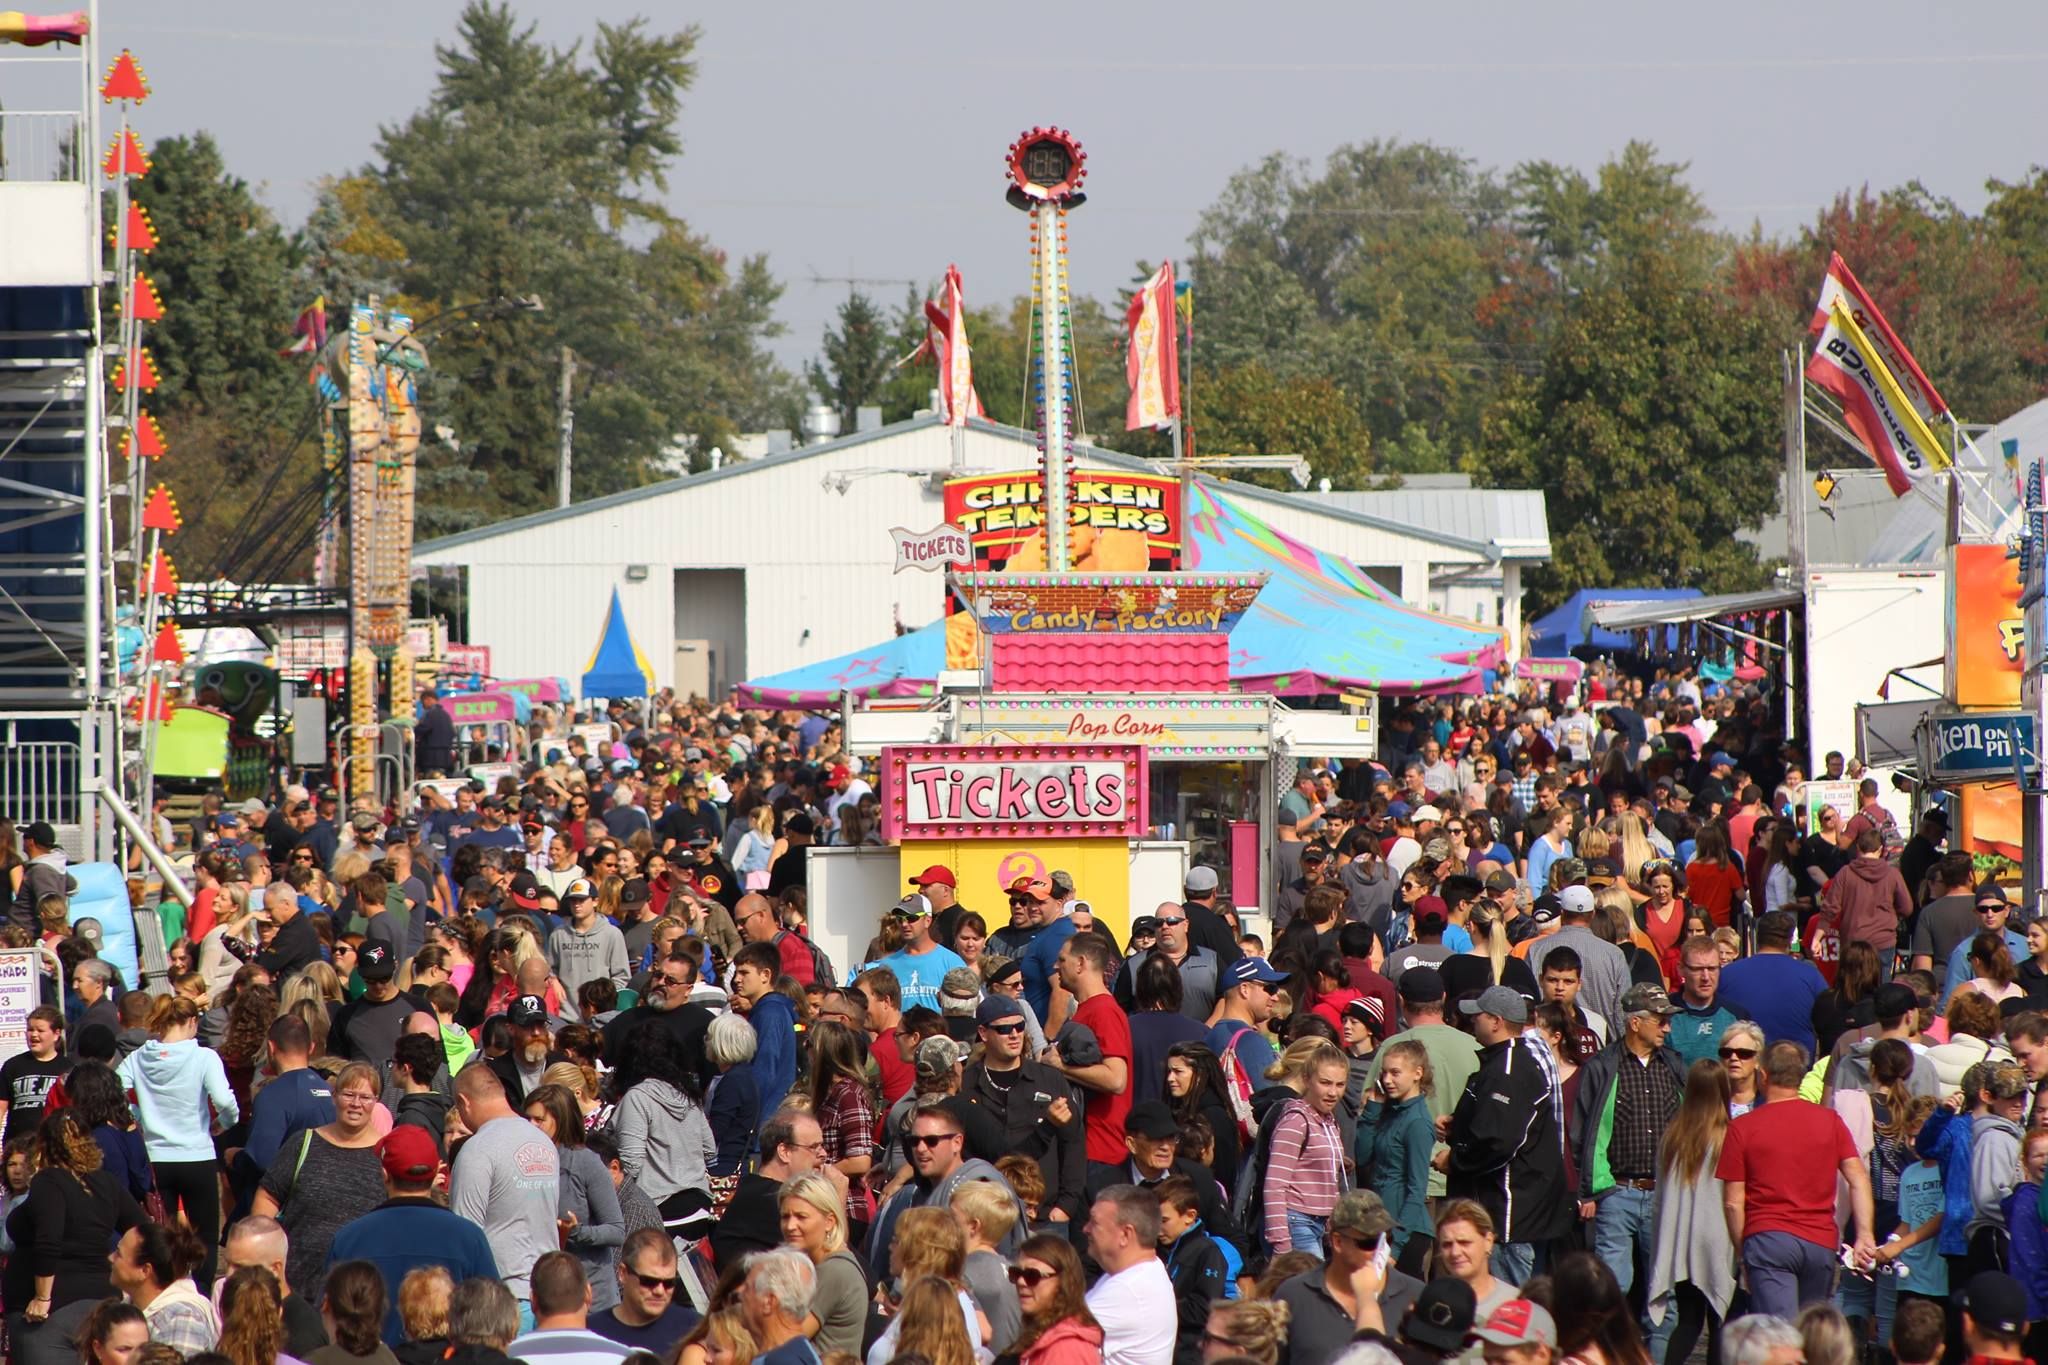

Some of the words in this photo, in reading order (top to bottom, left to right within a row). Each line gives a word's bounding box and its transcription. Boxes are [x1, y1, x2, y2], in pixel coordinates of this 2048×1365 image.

[1826, 337, 1921, 470] BURGERS
[964, 481, 1161, 510] CHIKEN
[901, 536, 966, 561] TICKETS
[1010, 605, 1097, 633] Candy
[1117, 605, 1223, 632] Factory
[455, 701, 498, 717] EXIT
[1067, 712, 1111, 740] Pop
[1113, 712, 1166, 736] Corn
[910, 765, 1122, 820] Tickets
[562, 943, 600, 951] BURTON
[1821, 937, 1840, 962] 13
[0, 966, 27, 977] NADO
[1, 996, 11, 1007] 3
[1697, 1023, 1713, 1035] AE
